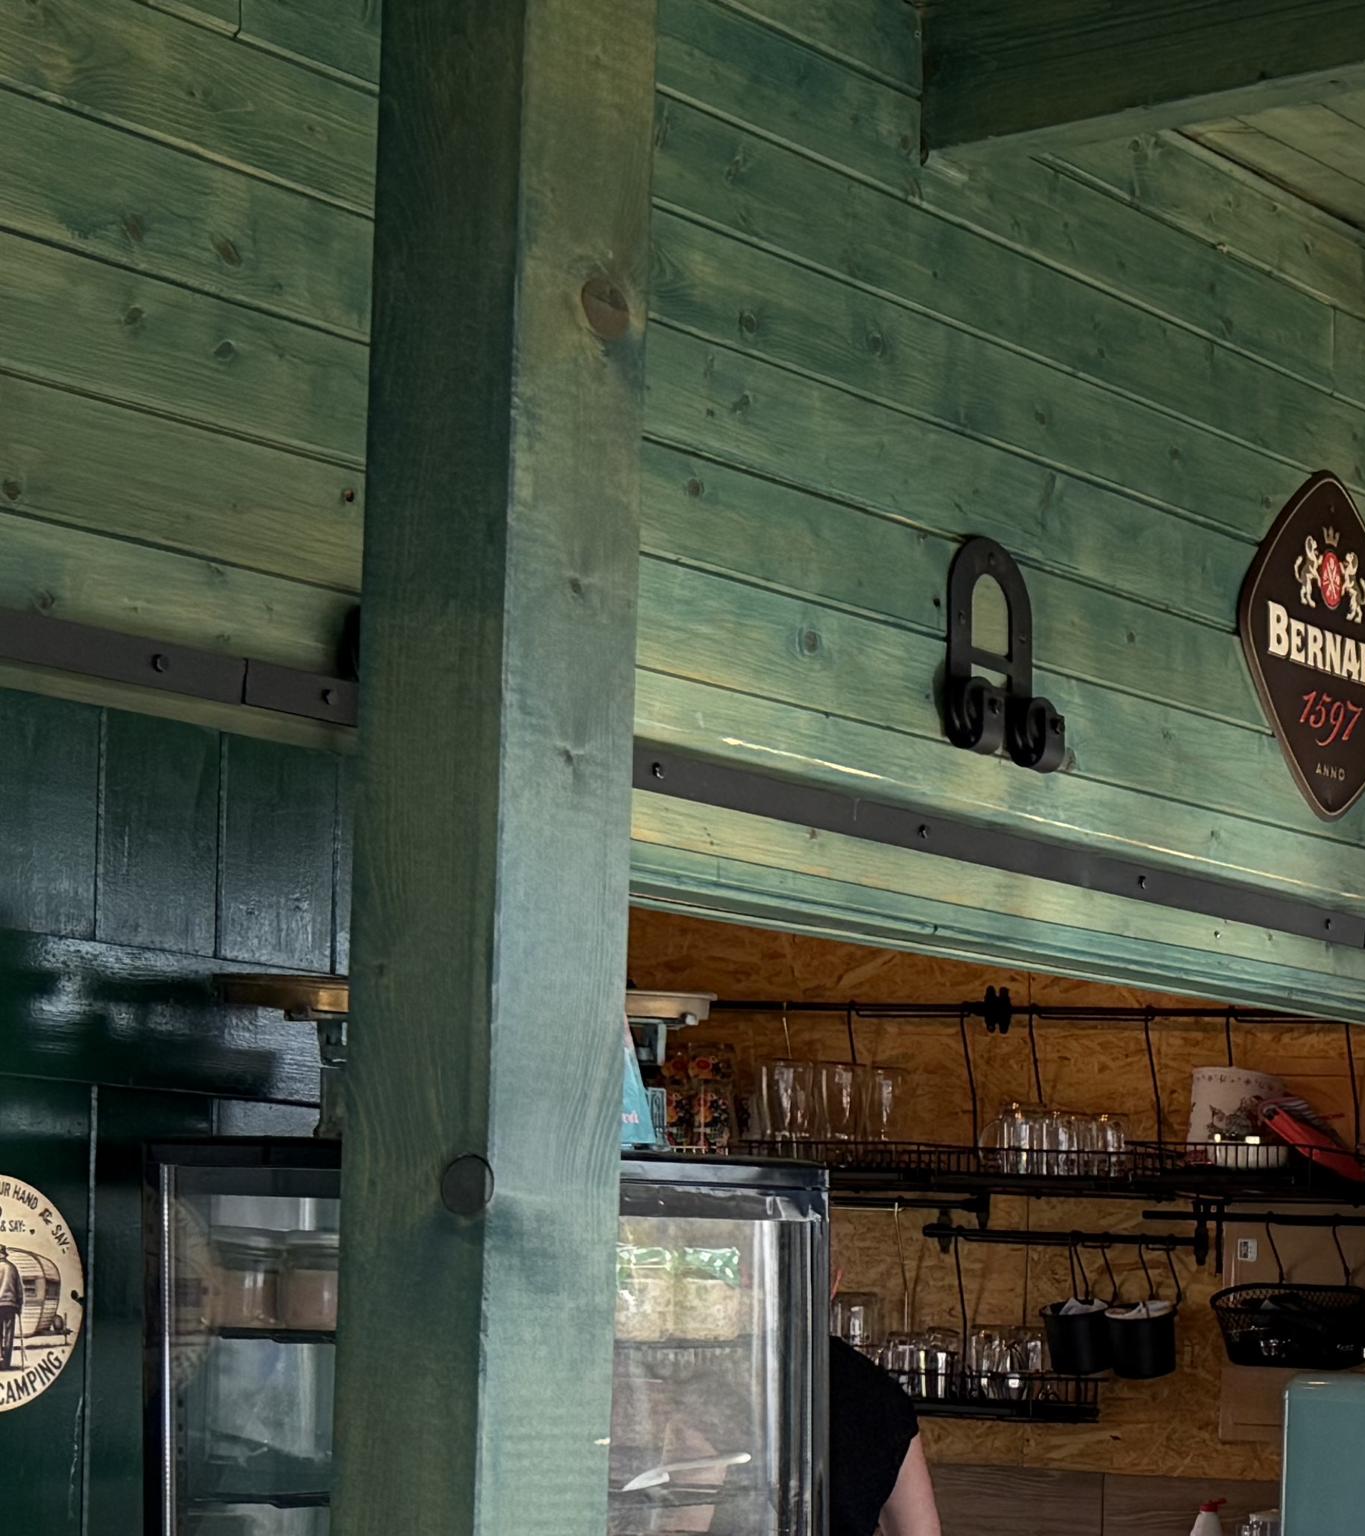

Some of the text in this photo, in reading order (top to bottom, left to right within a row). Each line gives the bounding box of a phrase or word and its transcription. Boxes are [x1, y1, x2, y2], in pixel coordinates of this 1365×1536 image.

[1298, 690, 1364, 748] 1597
[1315, 762, 1346, 781] ANNO
[12, 1184, 39, 1210] HAND
